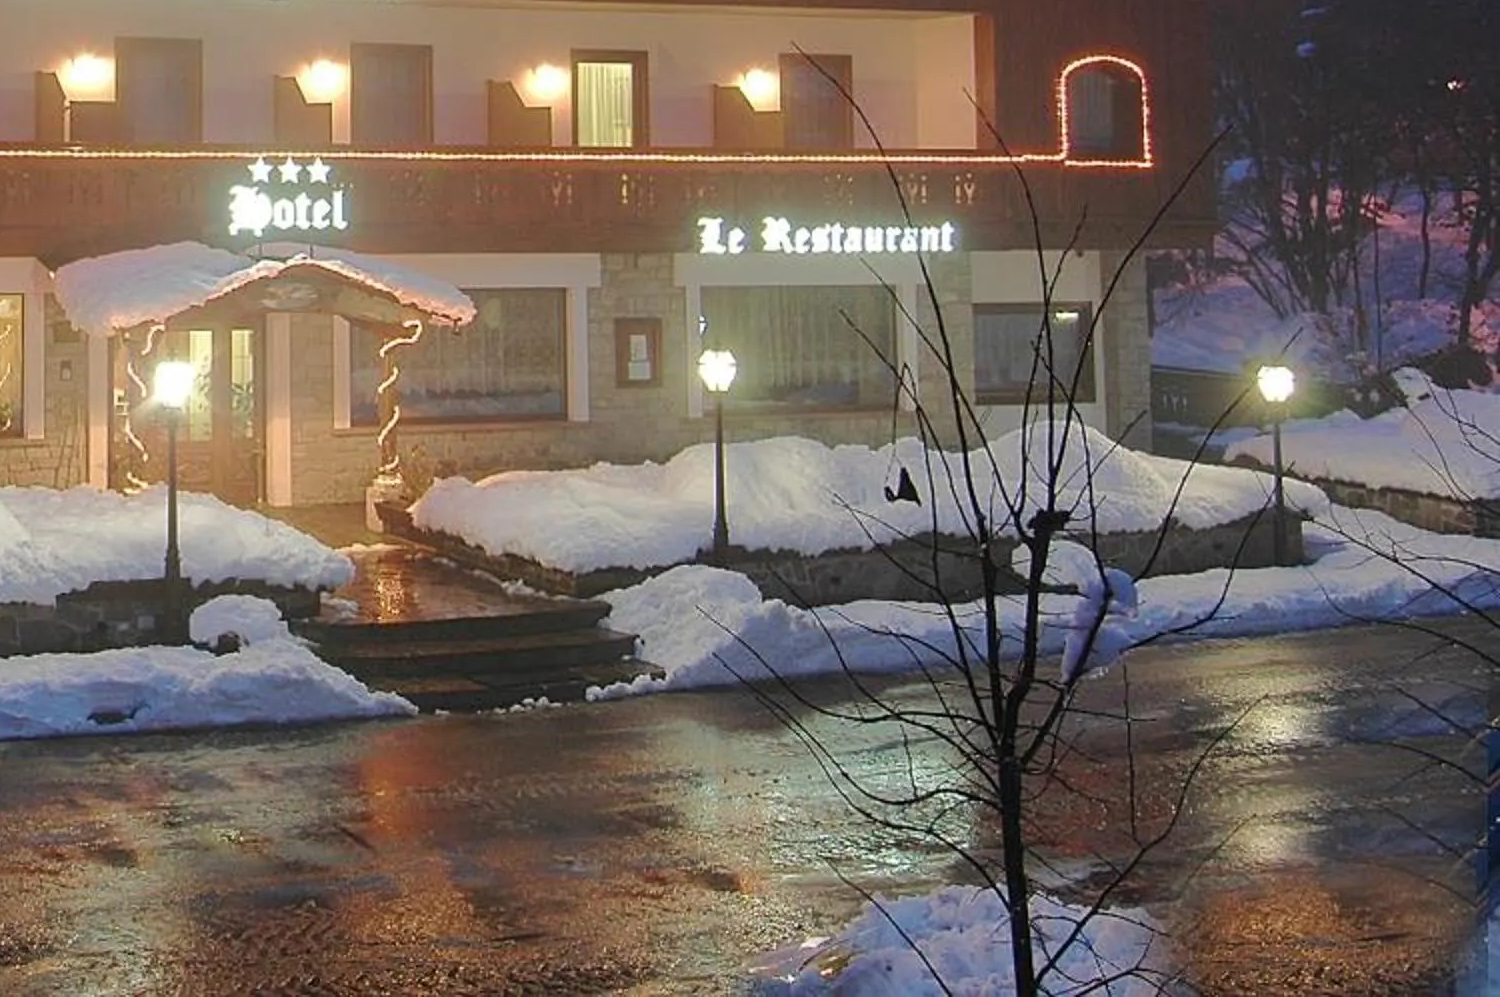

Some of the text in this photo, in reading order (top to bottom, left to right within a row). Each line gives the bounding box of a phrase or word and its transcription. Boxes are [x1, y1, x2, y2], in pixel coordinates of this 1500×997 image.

[229, 184, 347, 237] Hotel
[697, 216, 955, 254] Le Restaurant
